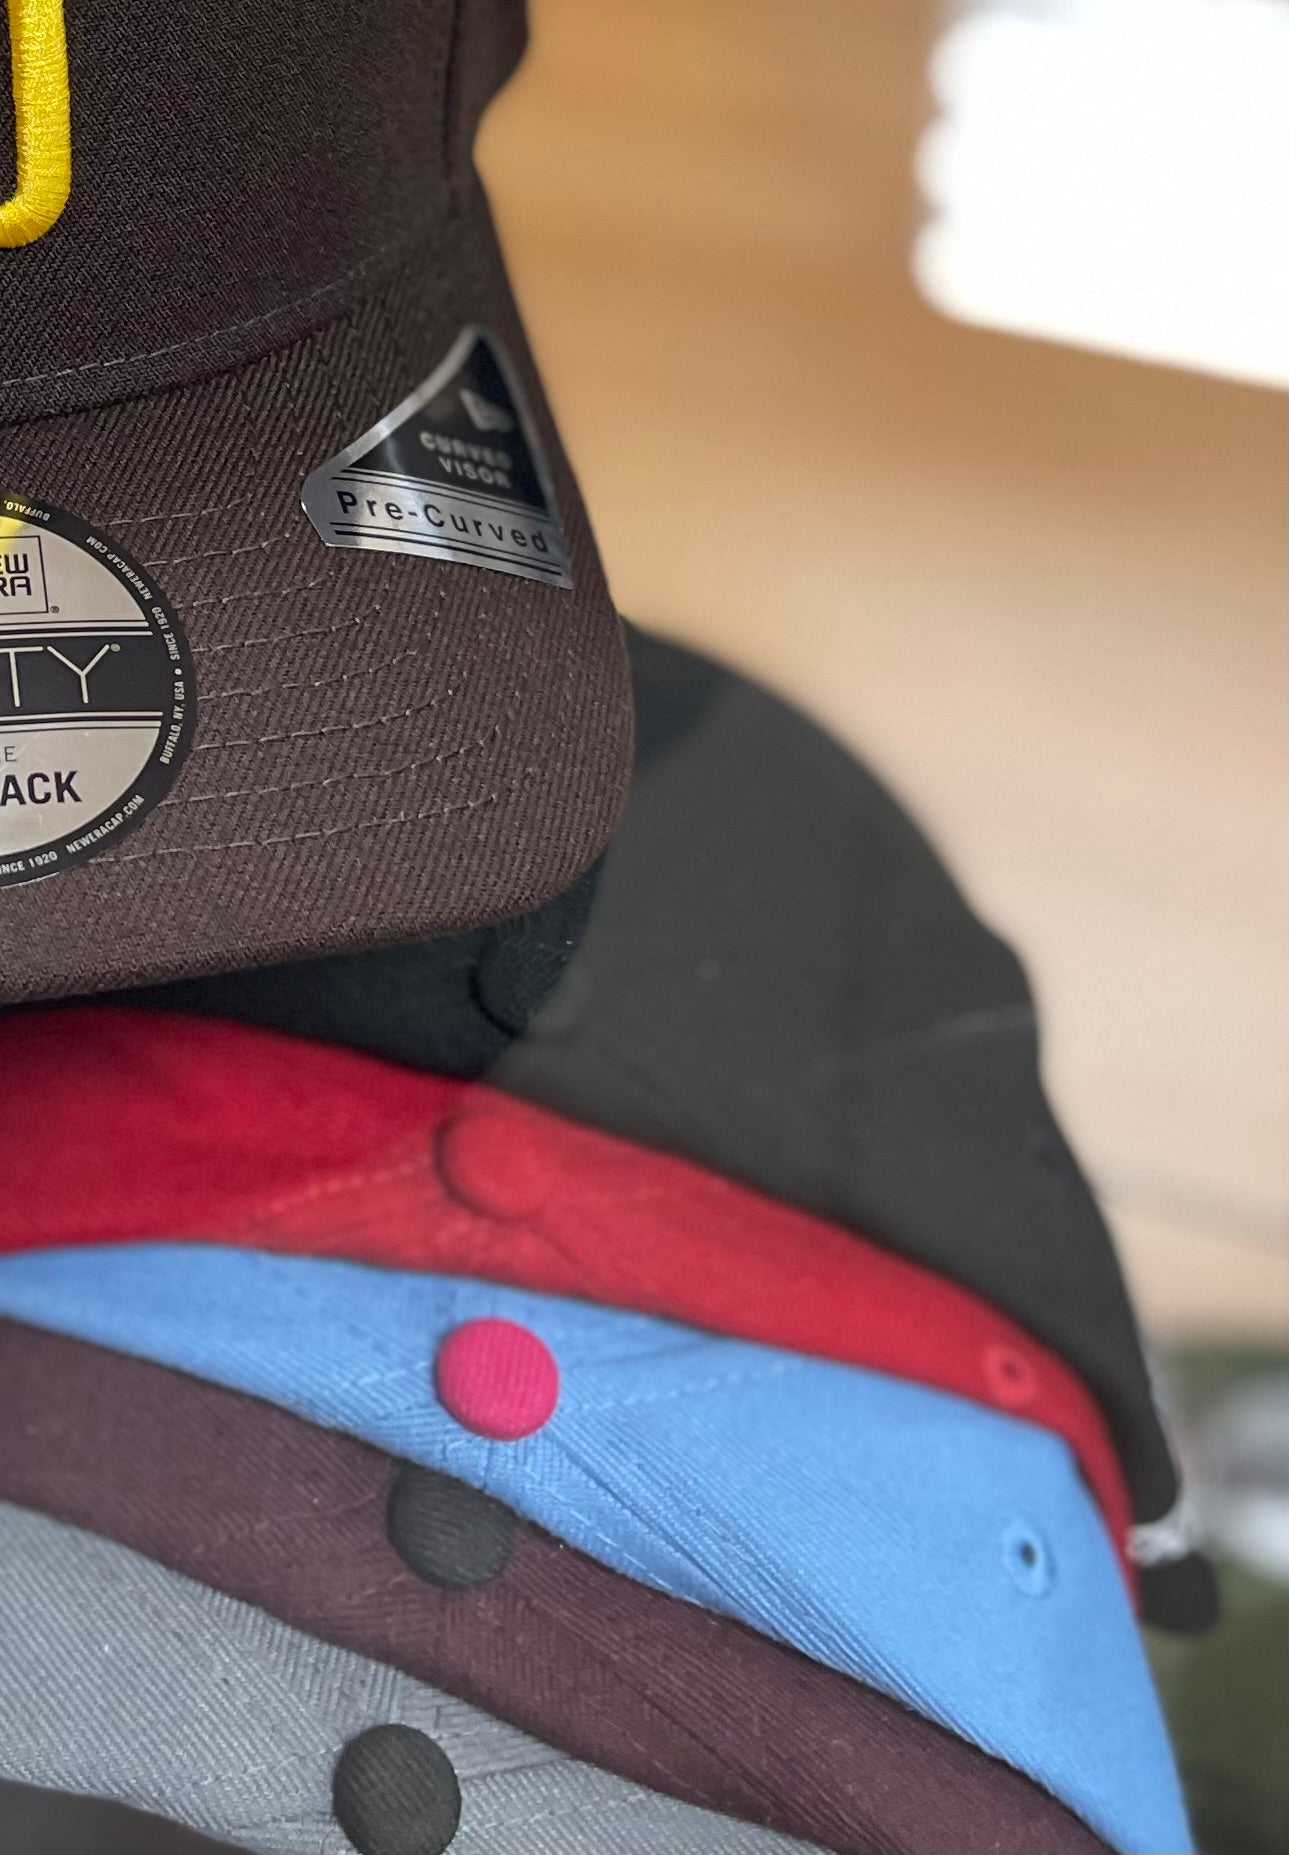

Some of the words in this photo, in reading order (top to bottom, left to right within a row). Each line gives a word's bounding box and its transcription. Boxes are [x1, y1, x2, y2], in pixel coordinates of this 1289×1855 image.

[438, 455, 512, 490] VISOR
[3, 499, 51, 522] BUFFALO,
[336, 490, 550, 554] Pre-Curved
[150, 605, 171, 631] 1920
[162, 632, 181, 662] SINCE
[174, 680, 186, 701] USA
[159, 723, 184, 765] BUFFALO,
[27, 850, 59, 870] 1920
[65, 794, 146, 854] NEWERACAP.COM
